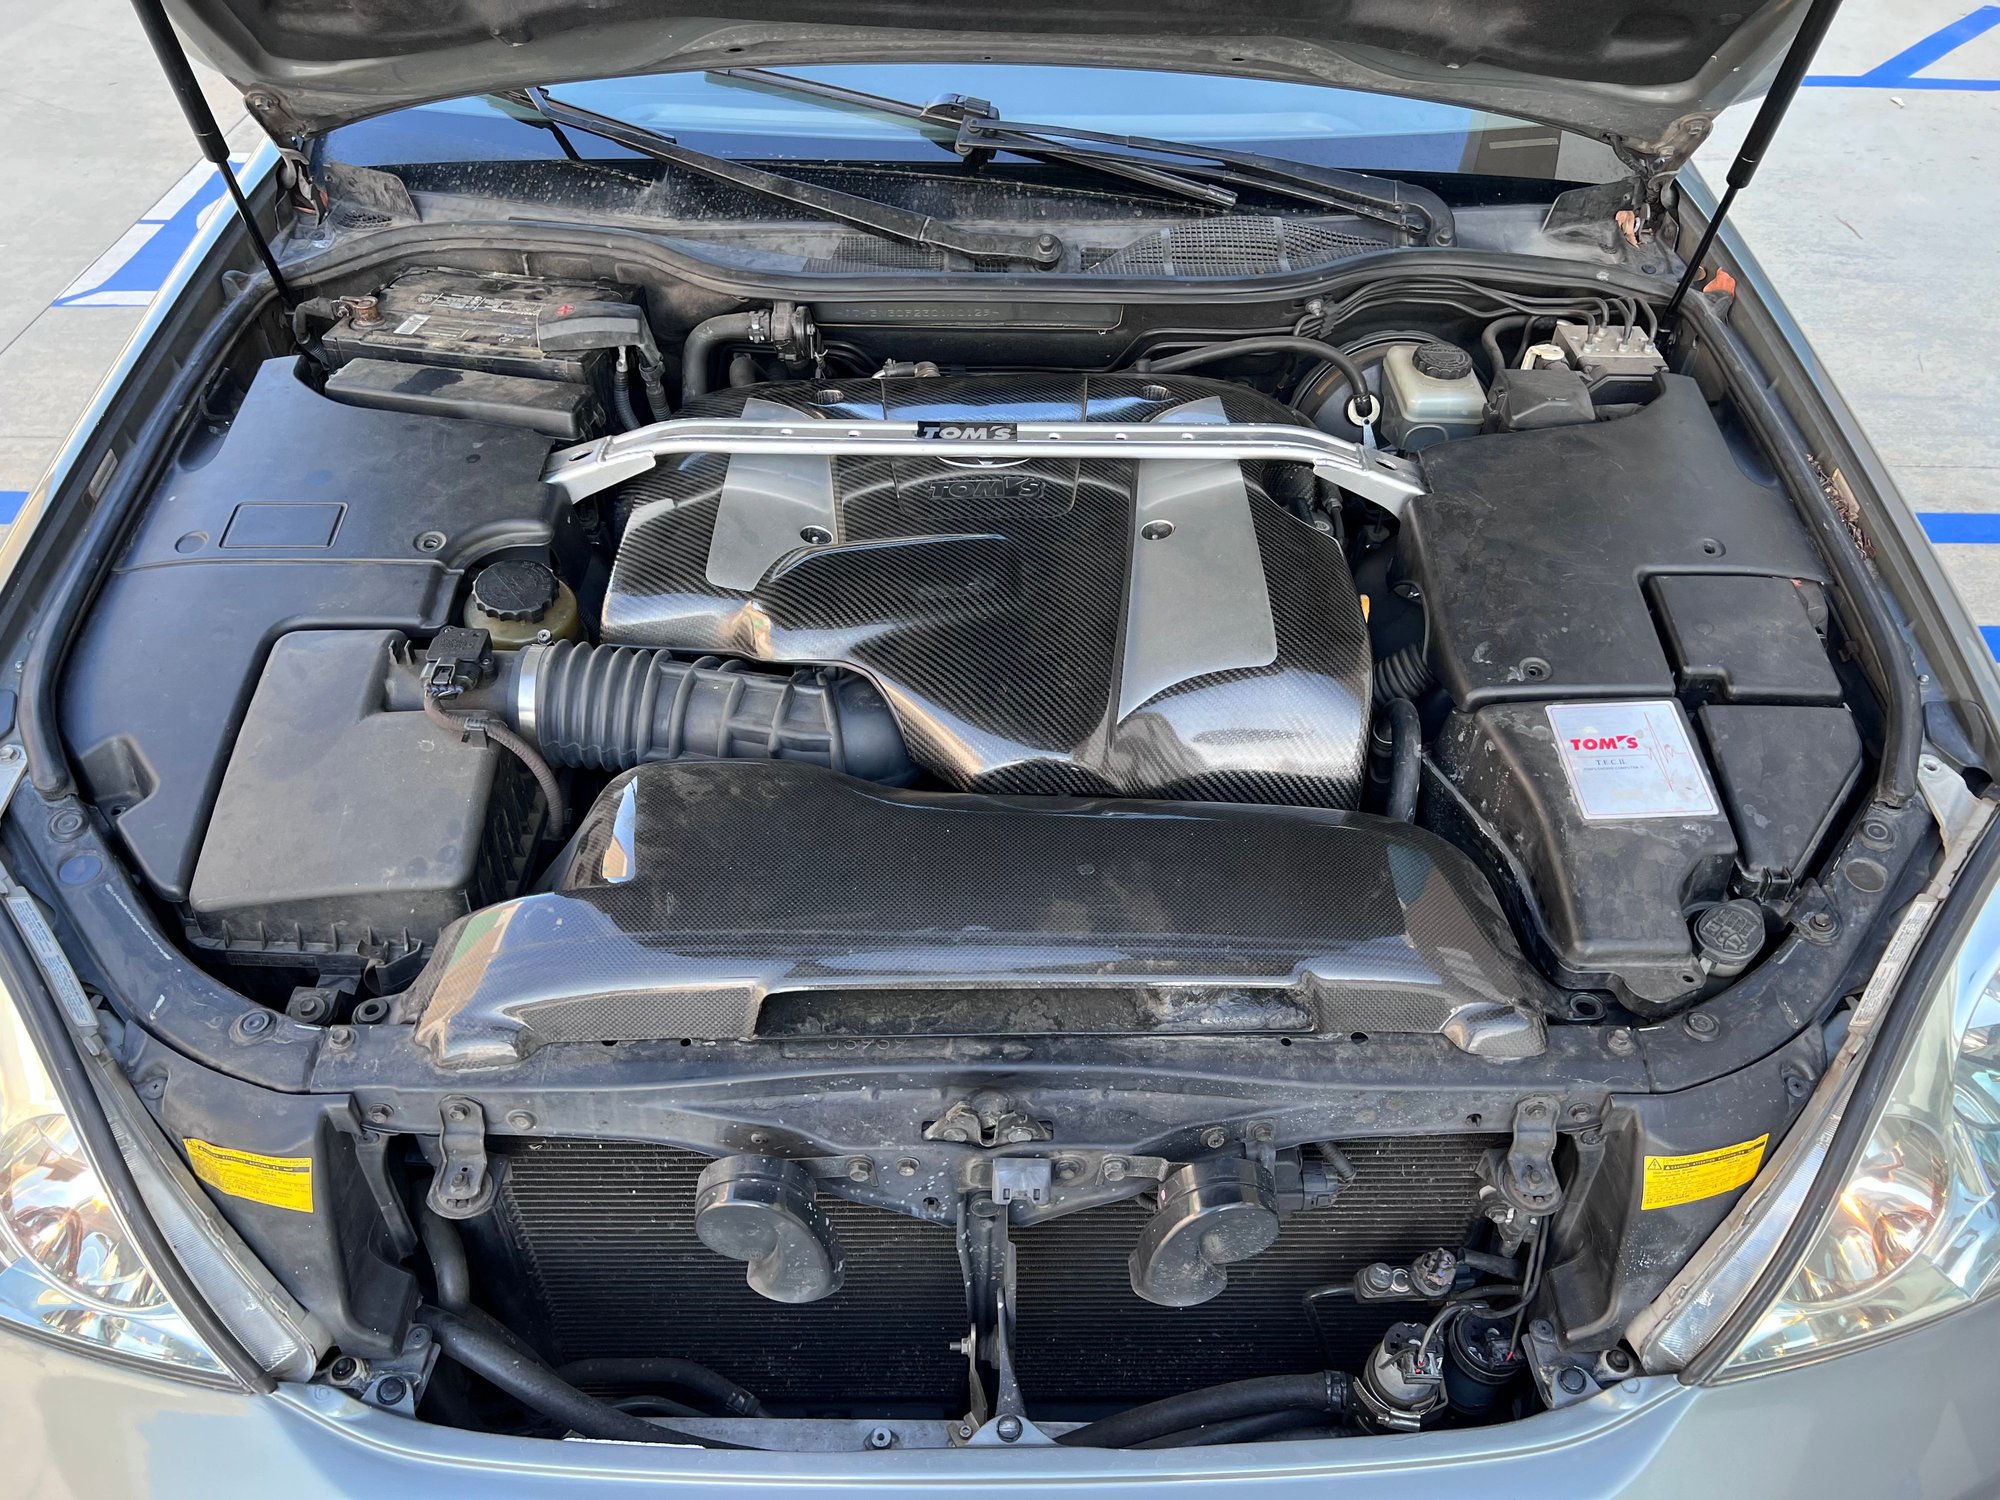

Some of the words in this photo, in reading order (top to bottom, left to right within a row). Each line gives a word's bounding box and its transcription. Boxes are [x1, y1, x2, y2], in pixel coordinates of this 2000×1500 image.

[923, 426, 1012, 440] TOM'S
[929, 477, 1046, 499] TOM'S
[1570, 735, 1639, 751] TOM'S
